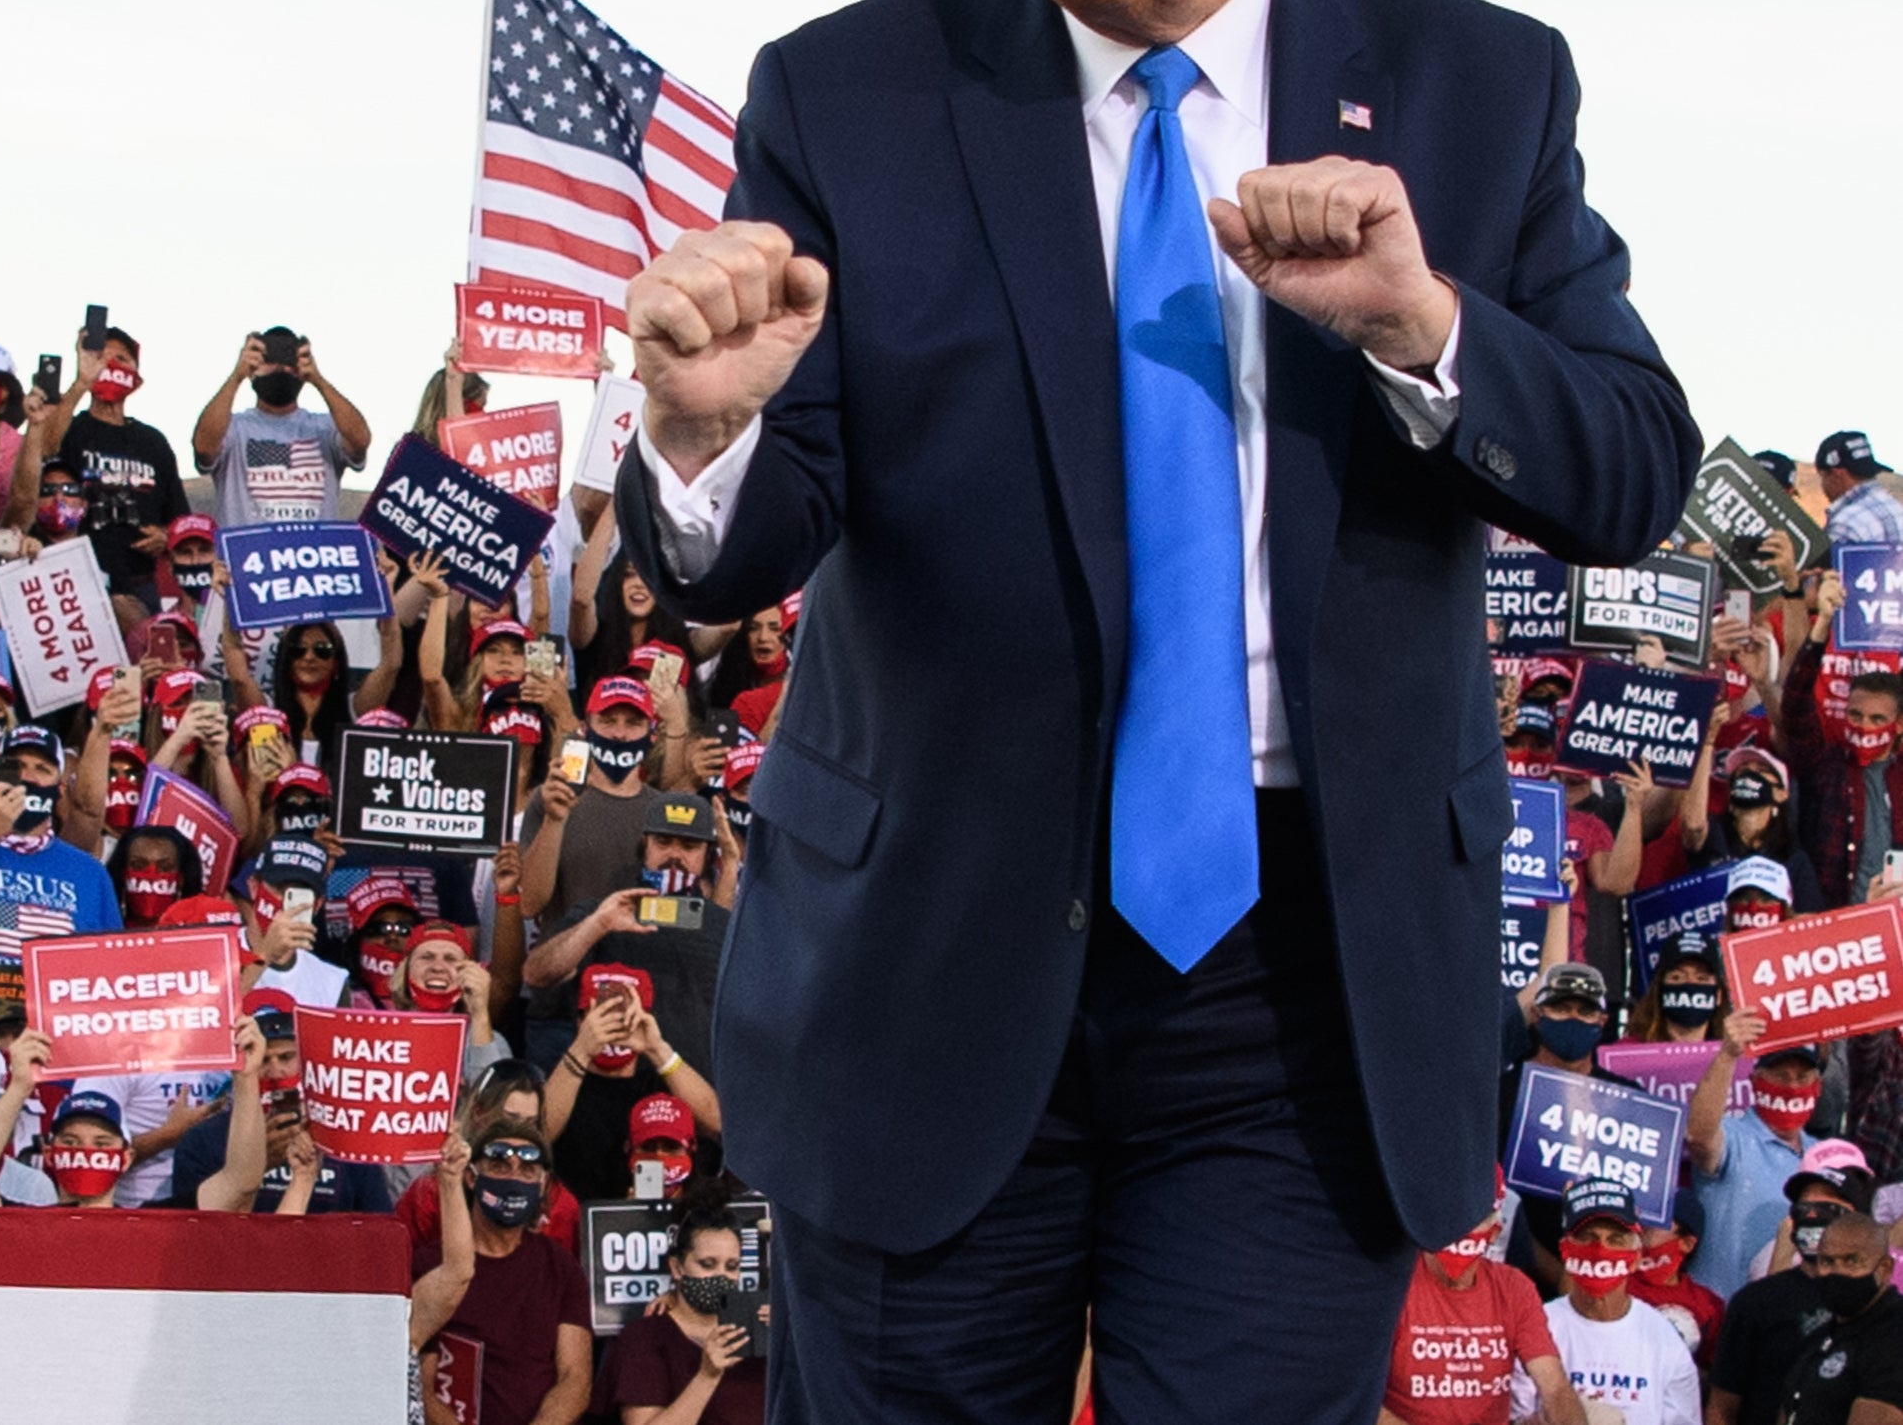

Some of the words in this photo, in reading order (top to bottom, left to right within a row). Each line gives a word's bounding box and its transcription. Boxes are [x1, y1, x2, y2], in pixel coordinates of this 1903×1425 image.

[475, 300, 495, 320] 4
[498, 302, 586, 329] MORE
[479, 326, 583, 355] YEARS!
[614, 411, 632, 432] 4
[466, 444, 485, 467] 4
[491, 431, 556, 464] MORE
[248, 469, 325, 483] TRUMP
[496, 462, 558, 493] EARS!
[437, 477, 500, 526] MAKE
[1706, 477, 1775, 539] VETER
[387, 475, 521, 570] AMERICA
[375, 497, 436, 553] GREAT
[442, 543, 510, 590] AGAIN
[242, 551, 264, 575] 4
[271, 546, 360, 570] MORE
[249, 574, 362, 604] YEARS!
[1584, 567, 1657, 605] COPS
[1854, 567, 1878, 594] 4
[21, 576, 66, 661] MORE
[1486, 590, 1567, 616] ERICA
[50, 568, 99, 673] YEARS!
[1589, 607, 1630, 623] FOR
[1640, 610, 1696, 635] TRUMP
[50, 662, 70, 683] 4
[1622, 683, 1678, 708] MAKE
[1575, 702, 1699, 744] AMERICA
[363, 745, 435, 782] Black
[1568, 730, 1637, 759] GREAT
[1641, 745, 1695, 768] AGAIN
[401, 780, 486, 813] Voices
[369, 813, 407, 829] FOR
[415, 818, 479, 835] TRUMP
[126, 877, 178, 896] MAGA
[1643, 899, 1727, 944] PEACEF
[1752, 958, 1777, 988] 4
[1783, 934, 1886, 982] MORE
[48, 969, 220, 1004] PEACEFUL
[1663, 992, 1716, 1010] MAGA
[1761, 972, 1891, 1025] YEARS!
[52, 1006, 220, 1038] PROTESTER
[333, 1036, 411, 1065] MAKE
[304, 1069, 451, 1103] AMERICA
[306, 1101, 365, 1132] GREAT
[371, 1105, 449, 1134] AGAIN
[1756, 1092, 1816, 1114] MAGA
[1540, 1103, 1564, 1133] 4
[1570, 1107, 1661, 1158] MORE
[53, 1151, 121, 1172] MAGA
[1539, 1139, 1651, 1192] YEARS!
[601, 1230, 669, 1272] COP
[1565, 1256, 1631, 1279] MAGA
[610, 1278, 658, 1299] FOR
[1570, 1371, 1648, 1391] RUMP
